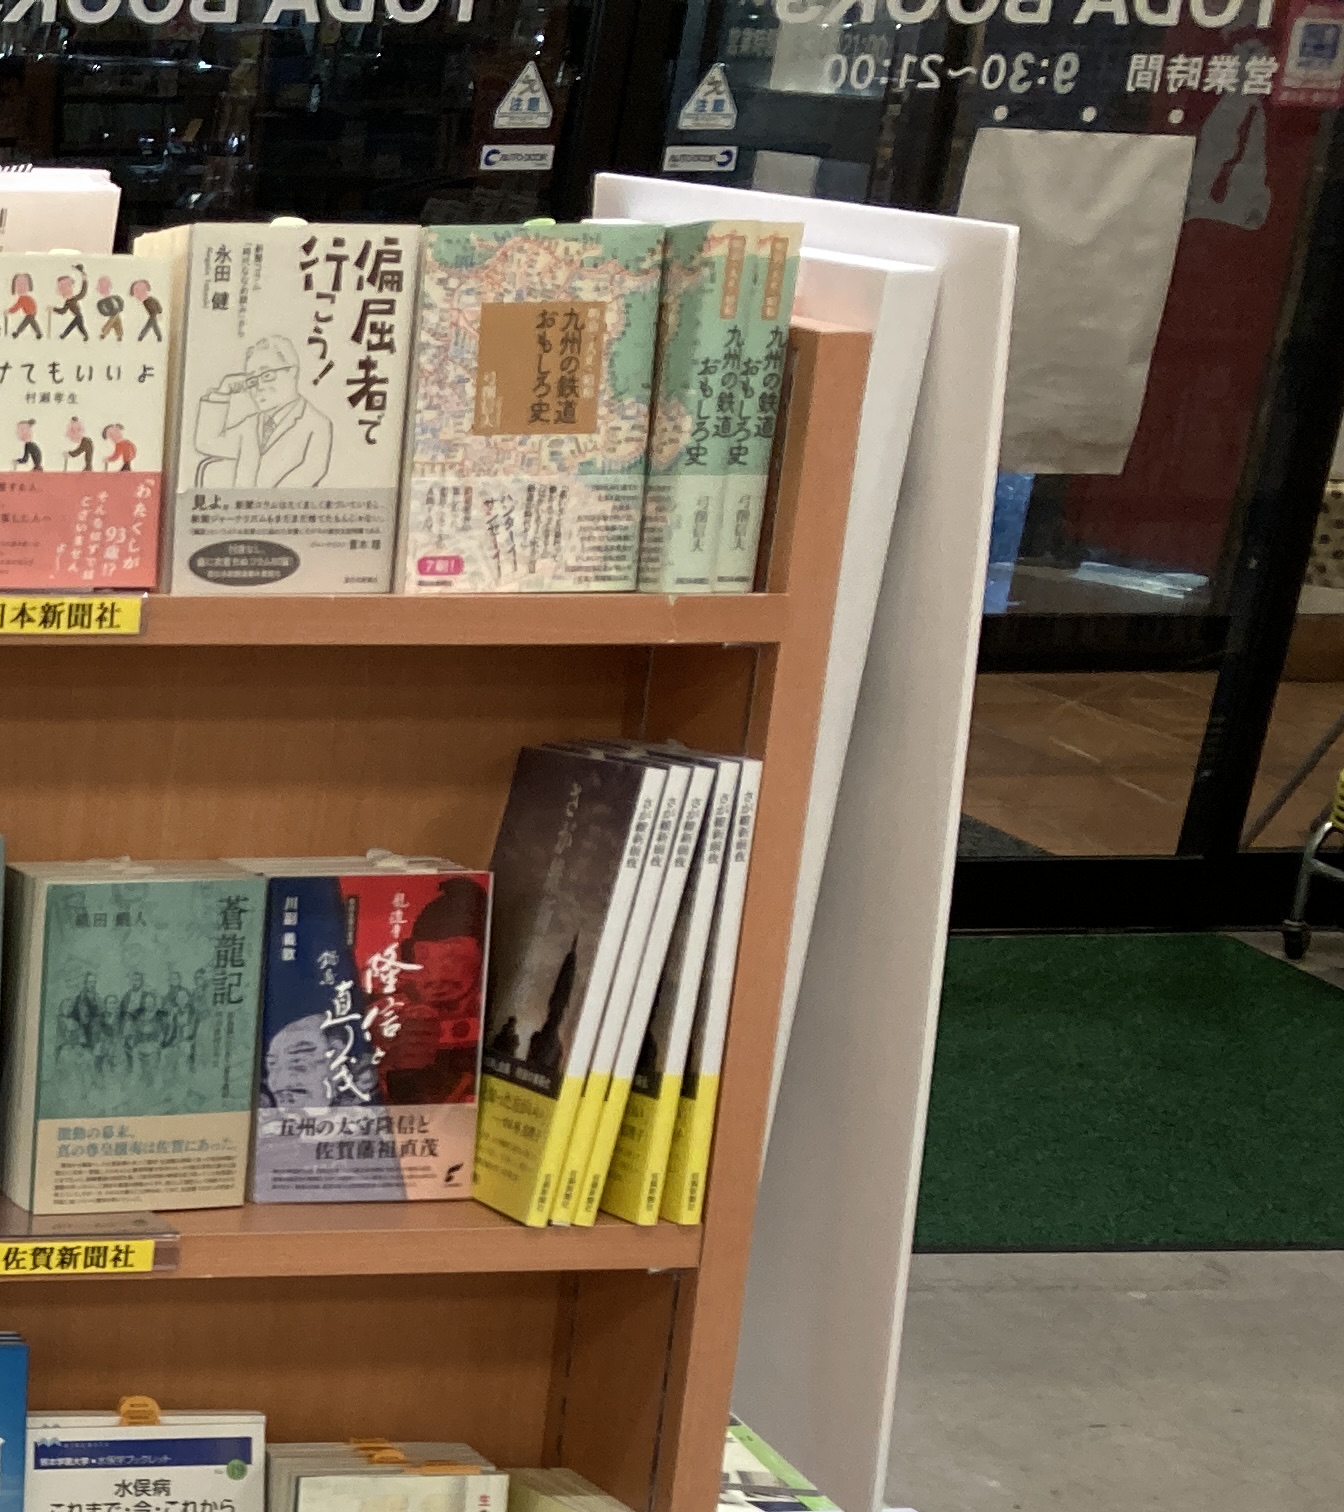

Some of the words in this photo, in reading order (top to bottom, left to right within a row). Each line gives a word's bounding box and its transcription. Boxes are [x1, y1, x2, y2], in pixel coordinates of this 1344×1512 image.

[212, 291, 229, 312] 健
[213, 244, 231, 283] 永田
[299, 235, 350, 385] 行こう!
[346, 236, 404, 445] 偏屈者で
[529, 309, 557, 425] おもしろ史
[554, 307, 585, 425] 九州の鉄道
[212, 894, 250, 1008] 蒼龍記
[2, 1245, 136, 1271] 佐賀新聞社
[113, 1478, 172, 1498] 水俣病
